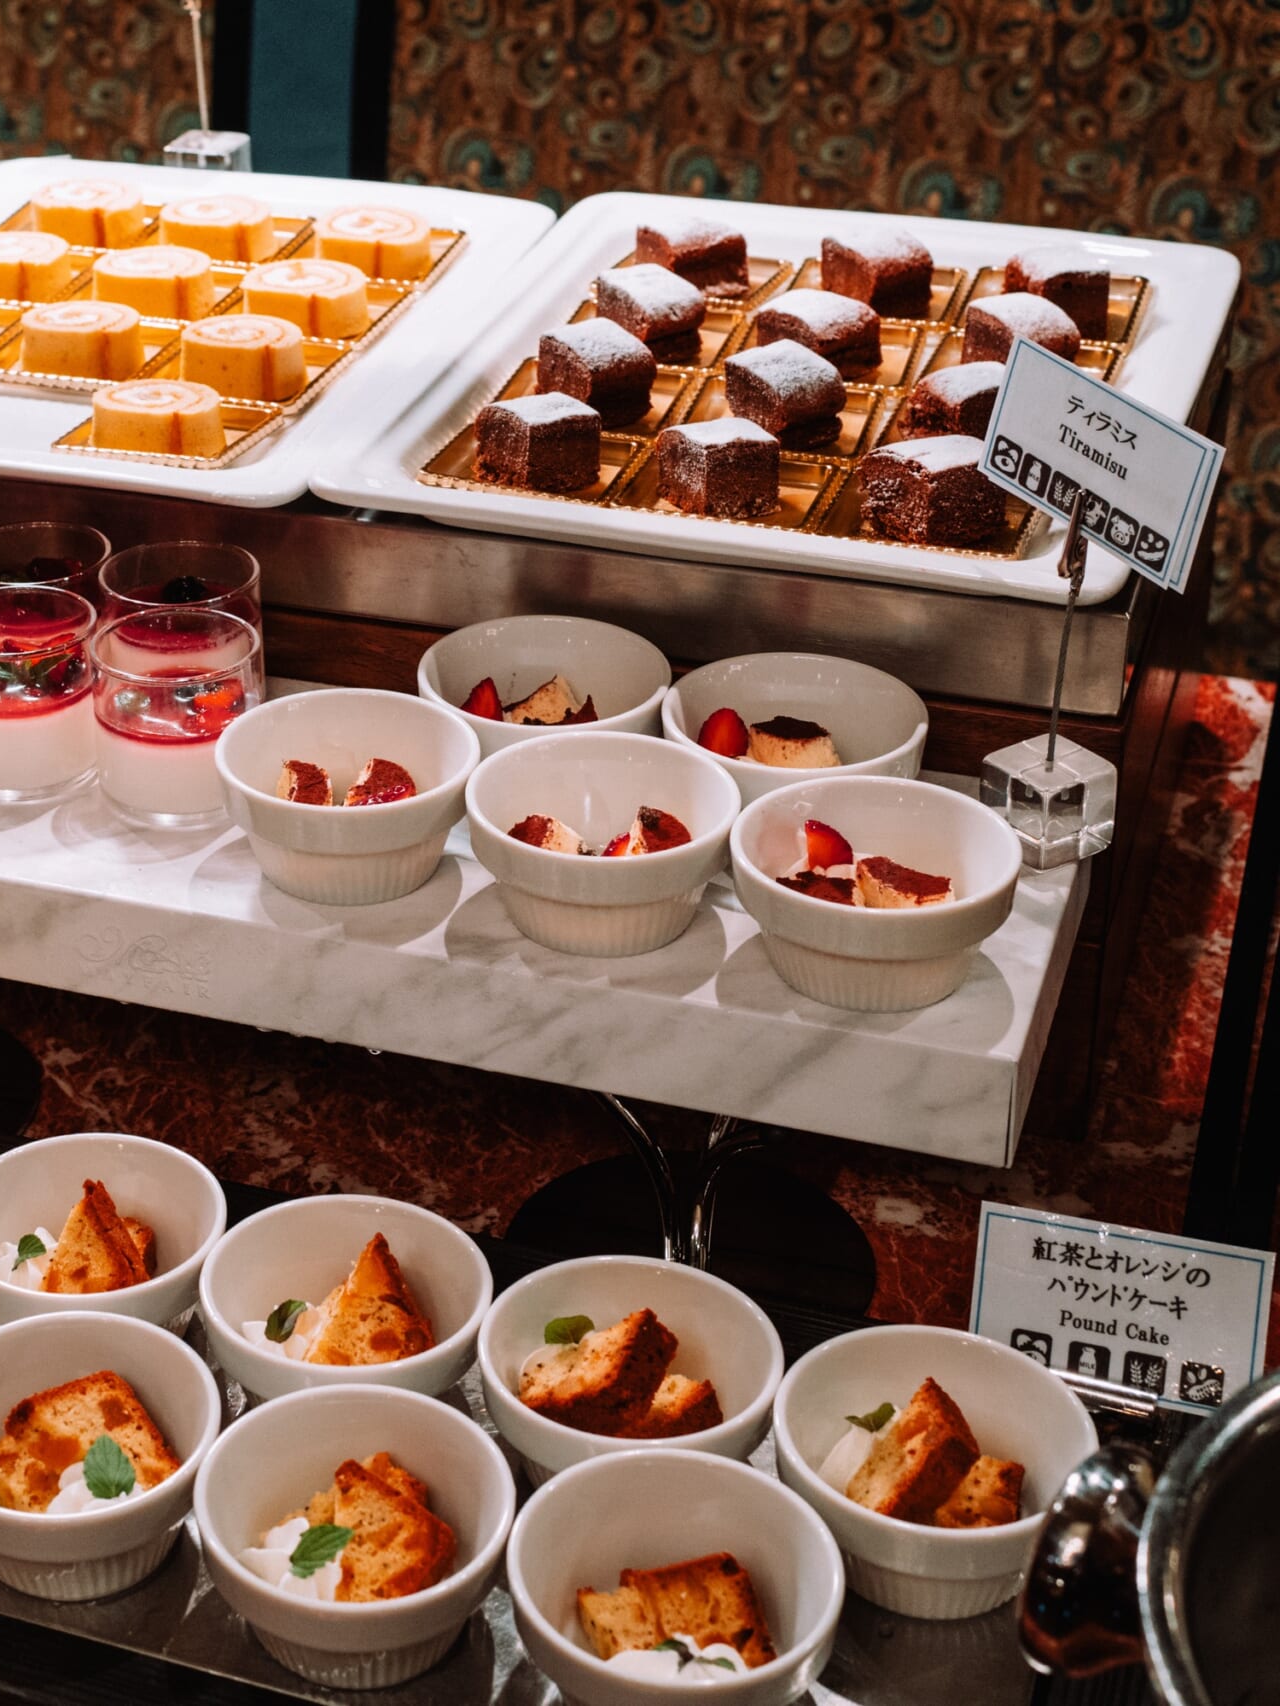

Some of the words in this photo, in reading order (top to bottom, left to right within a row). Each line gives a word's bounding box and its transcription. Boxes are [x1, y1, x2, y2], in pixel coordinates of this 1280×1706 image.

[1067, 394, 1138, 451] ティラミス
[1059, 423, 1129, 480] Tiramisu
[1031, 1236, 1211, 1288] 紅茶とオレンジの
[1047, 1275, 1189, 1321] パウンドケーキ
[1058, 1310, 1118, 1337] Pound
[1125, 1322, 1170, 1346] Cake
